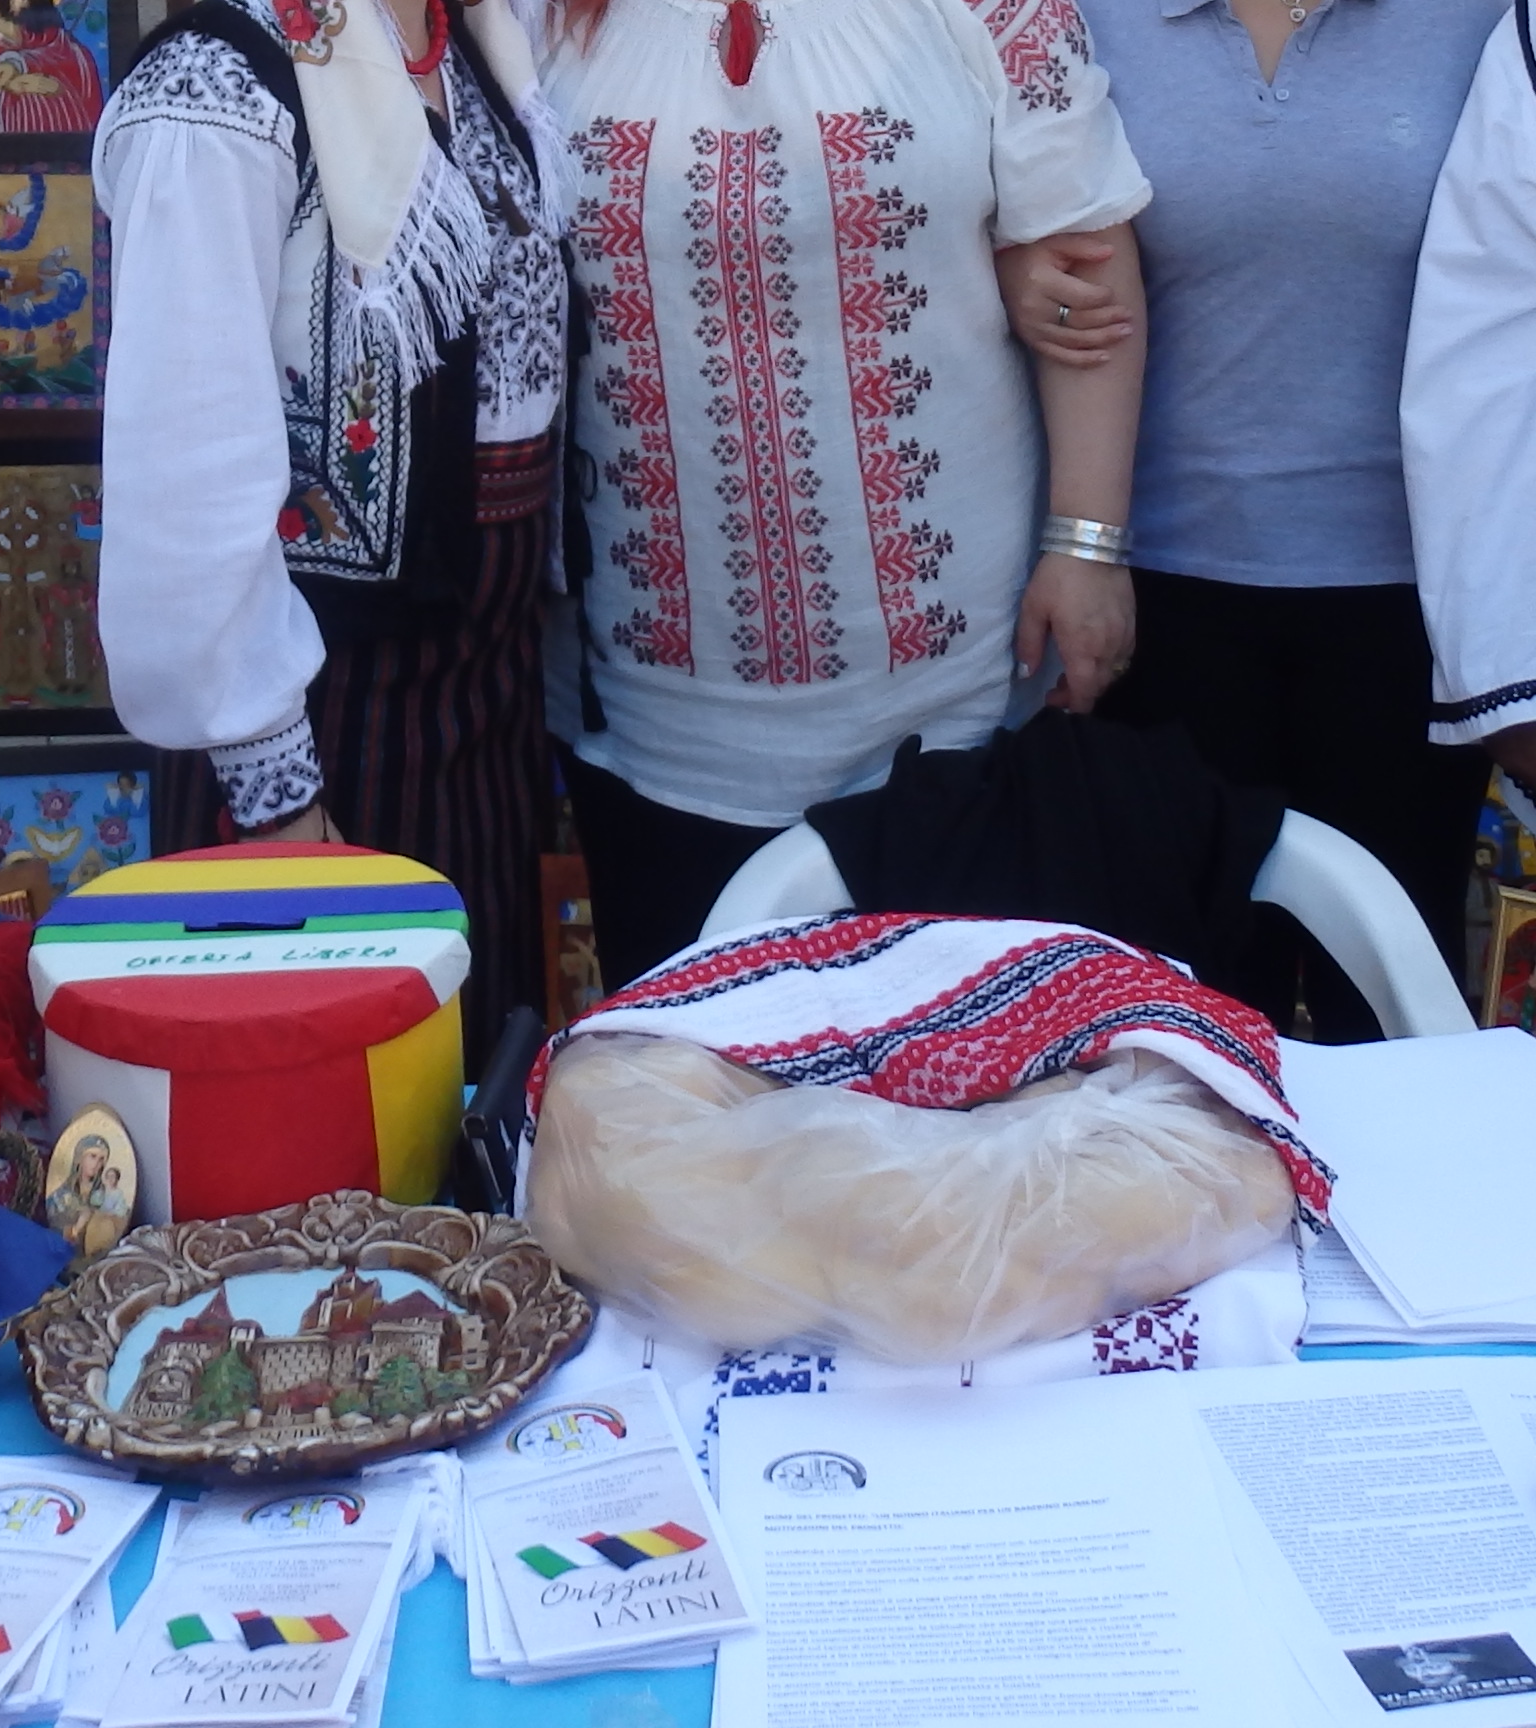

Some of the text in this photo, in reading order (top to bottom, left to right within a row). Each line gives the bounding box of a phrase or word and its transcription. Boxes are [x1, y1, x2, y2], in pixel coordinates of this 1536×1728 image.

[541, 1558, 711, 1608] Orizzonti
[593, 1589, 720, 1629] LATINI
[184, 1680, 318, 1705] LATINI
